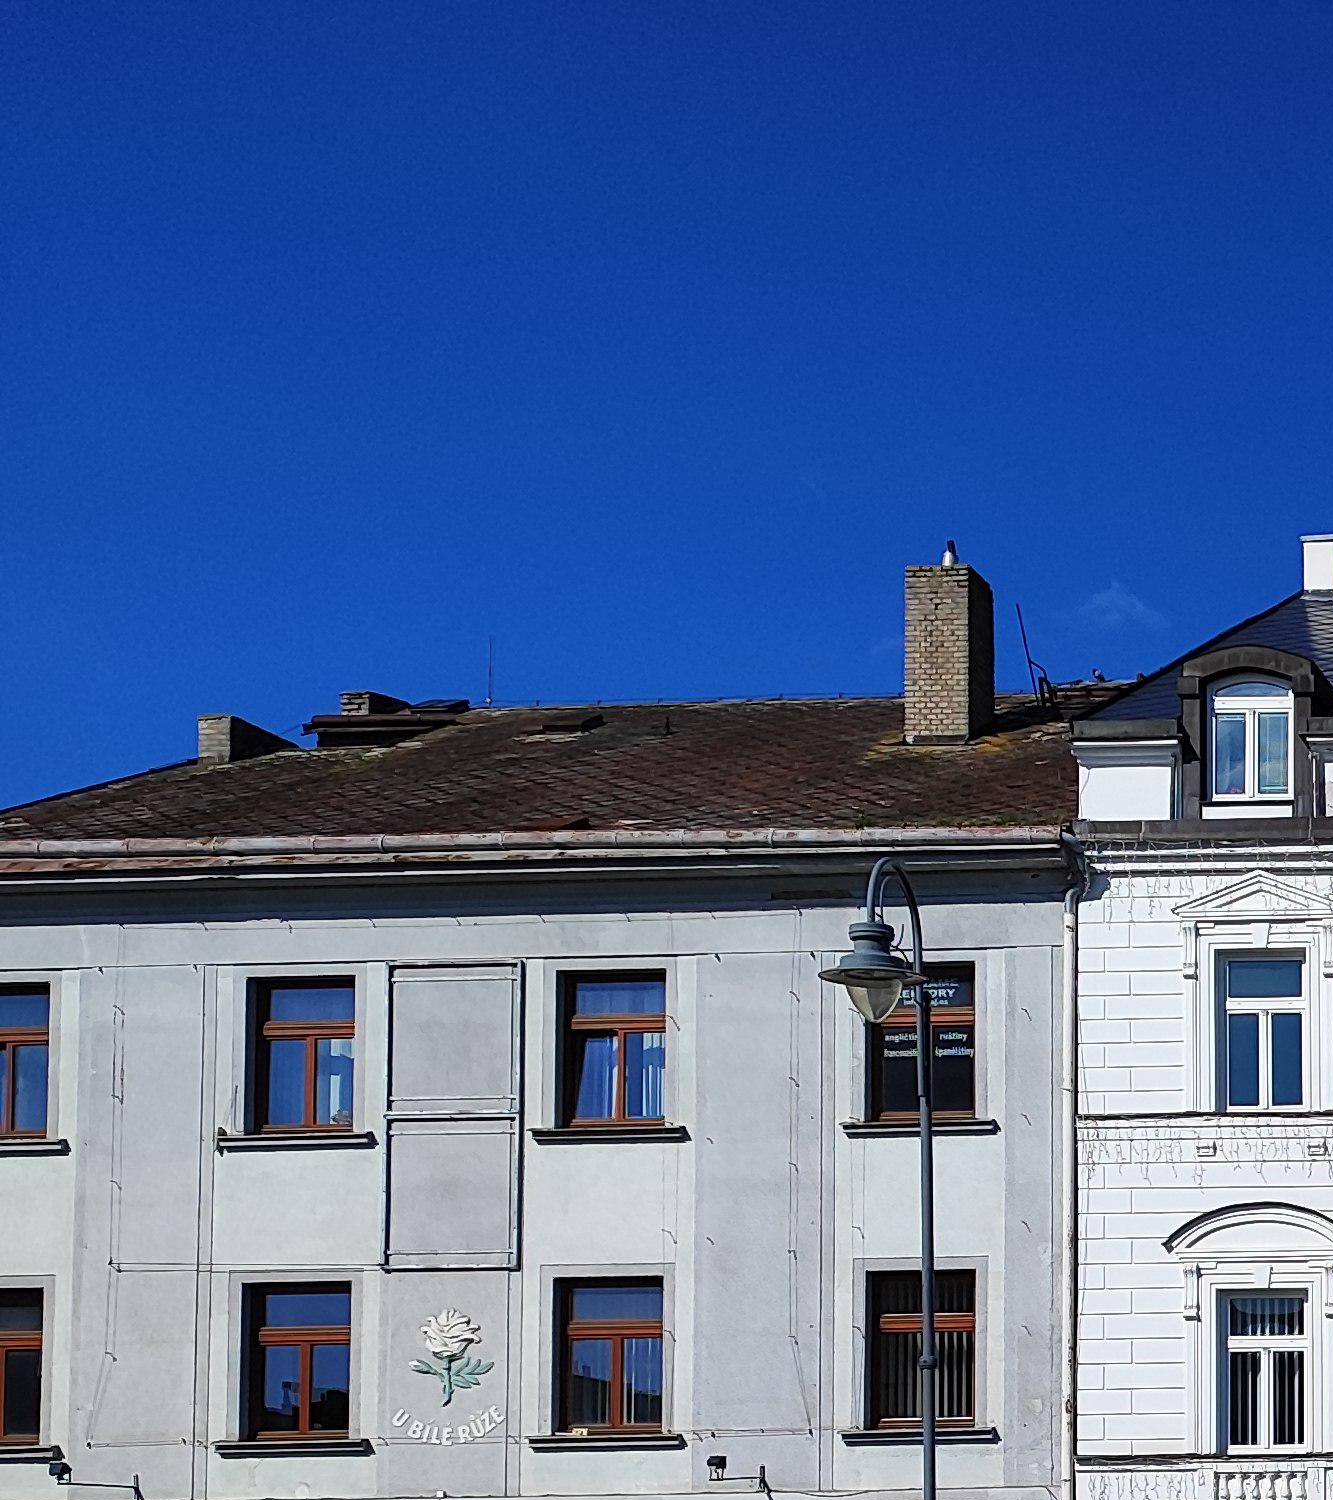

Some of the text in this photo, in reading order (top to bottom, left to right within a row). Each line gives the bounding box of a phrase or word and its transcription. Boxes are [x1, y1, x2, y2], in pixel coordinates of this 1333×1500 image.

[392, 1405, 507, 1446] U BÍLÉ RŮŽE
